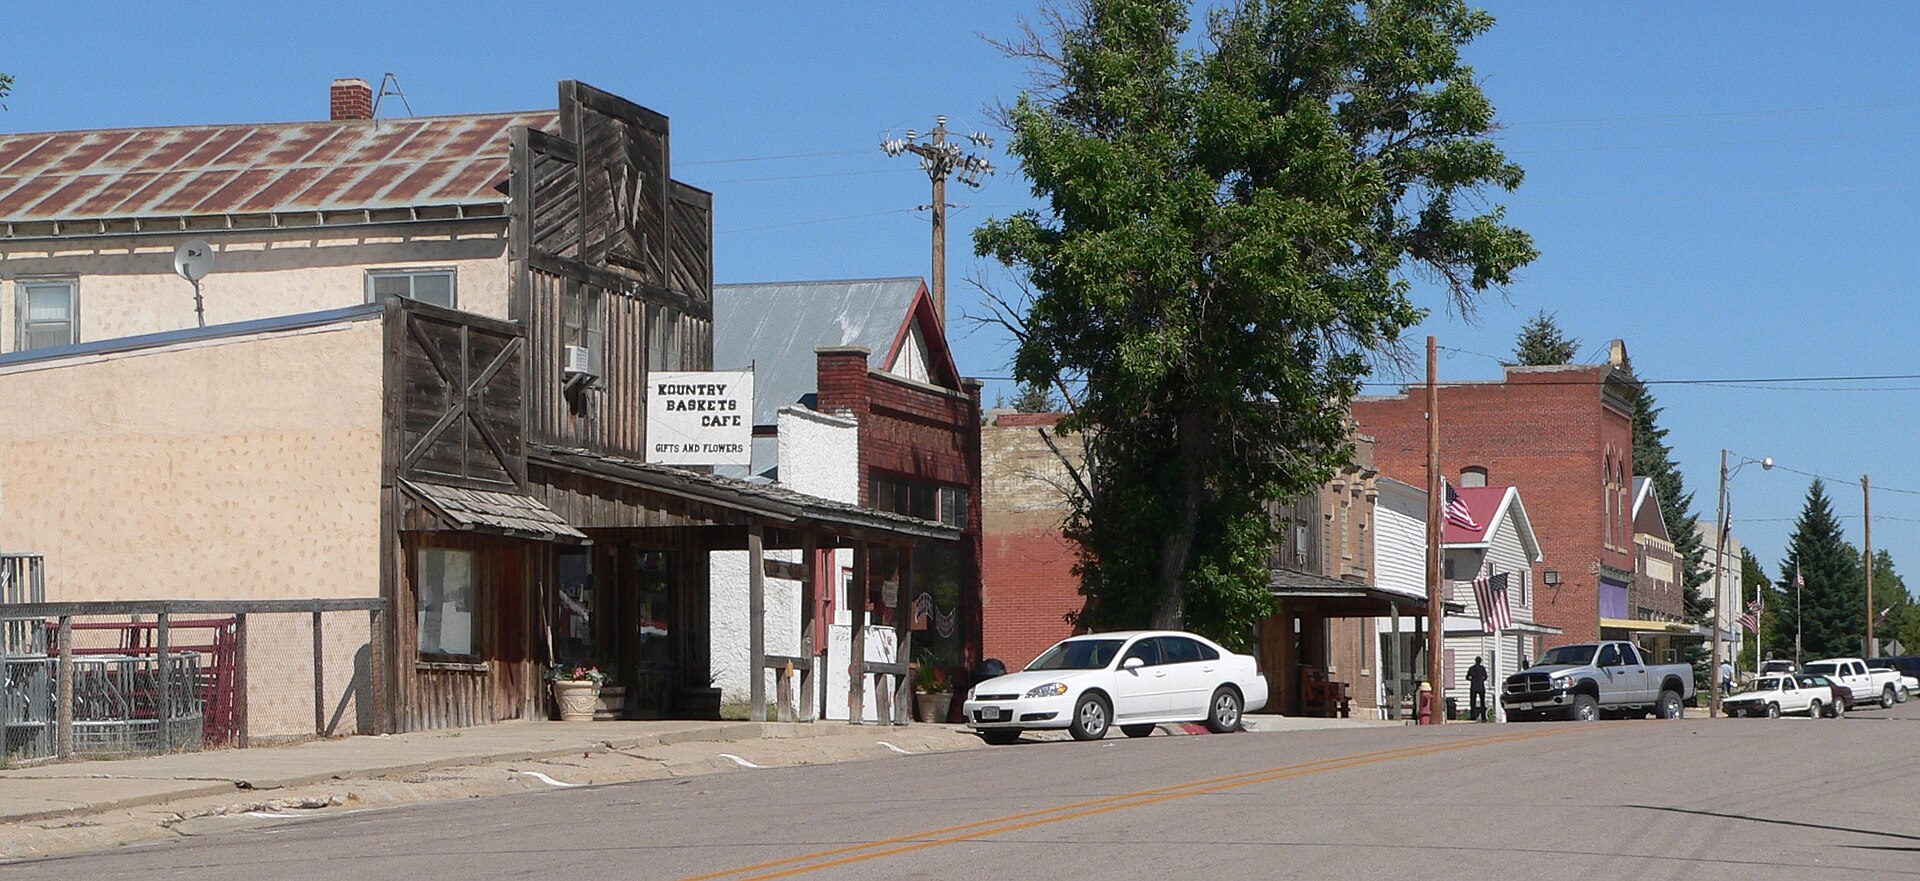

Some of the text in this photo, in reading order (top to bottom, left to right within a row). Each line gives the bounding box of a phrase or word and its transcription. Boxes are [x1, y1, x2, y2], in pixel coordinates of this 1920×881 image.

[658, 384, 727, 396] KOUNTRY
[666, 399, 737, 411] BASKETS
[701, 415, 741, 427] CAFE
[655, 443, 744, 453] GIFTS AND FLOWERS
